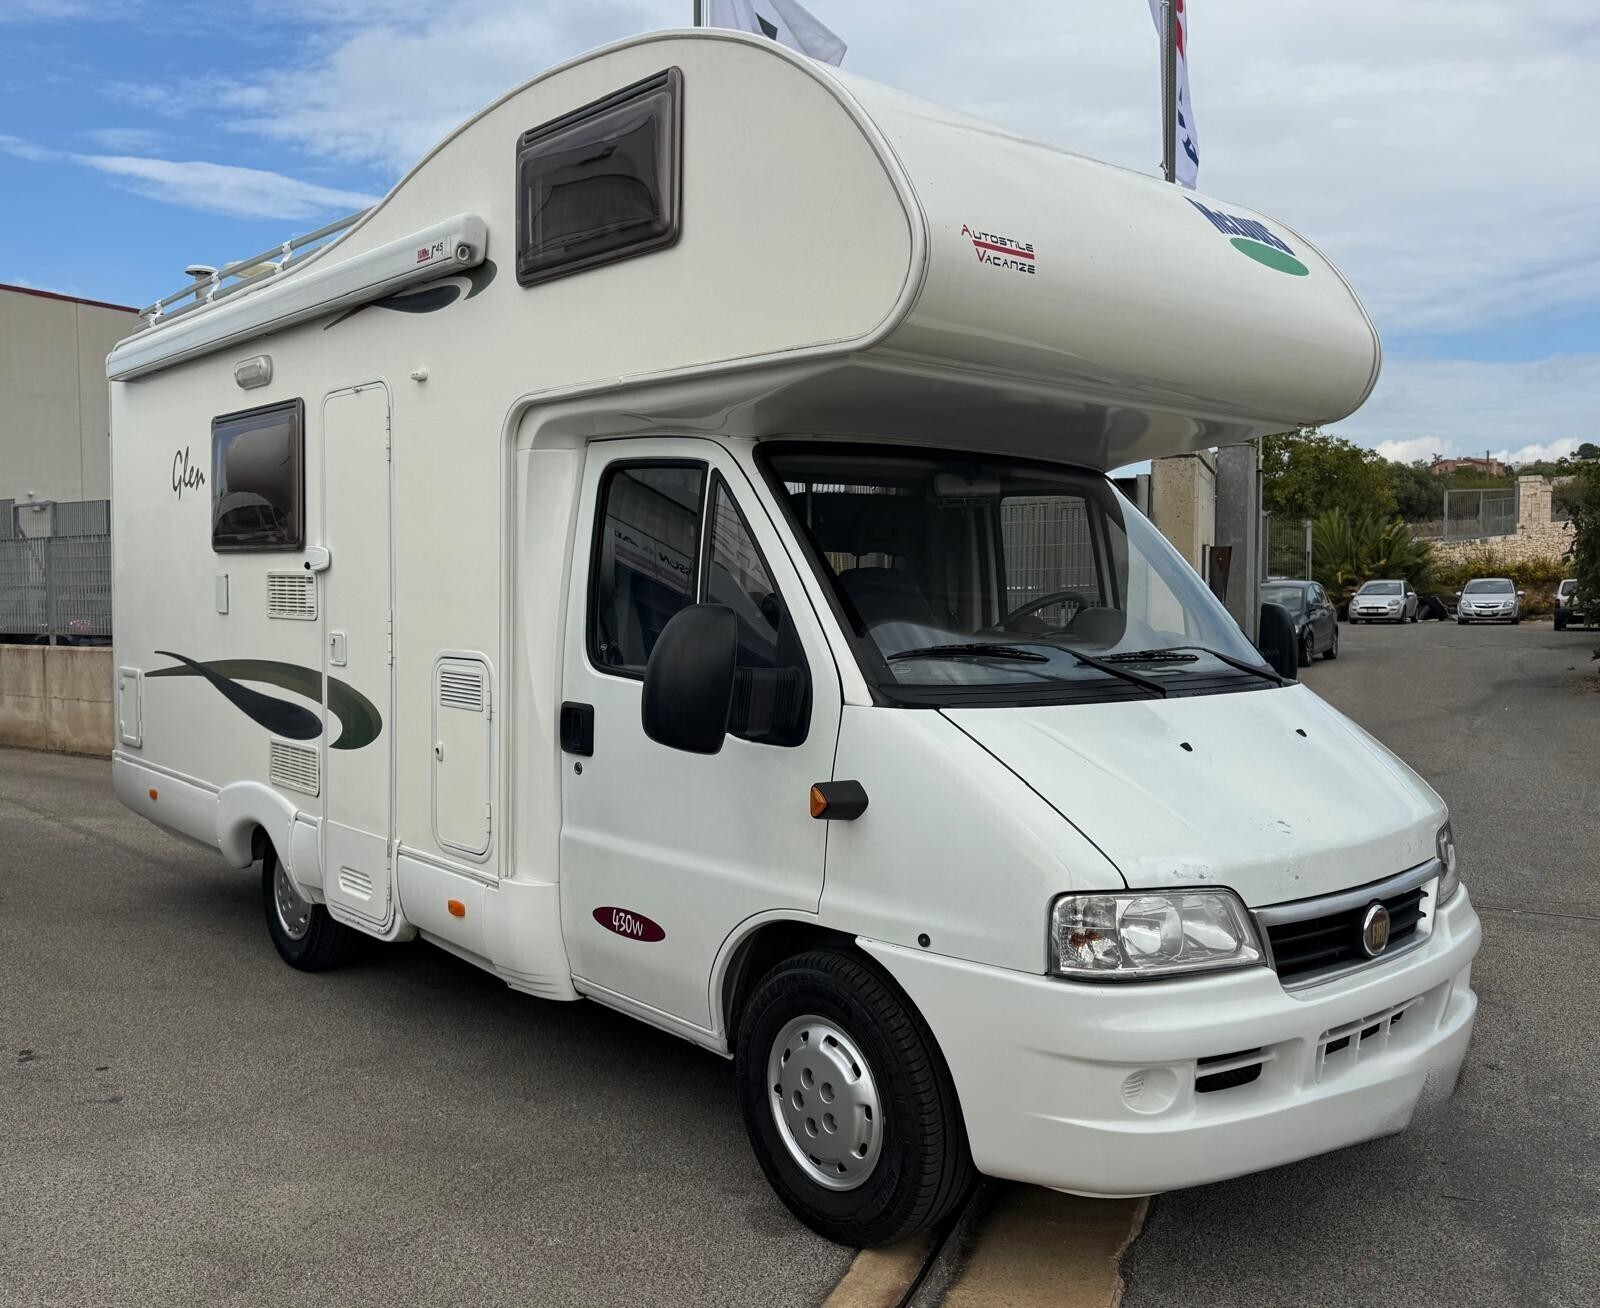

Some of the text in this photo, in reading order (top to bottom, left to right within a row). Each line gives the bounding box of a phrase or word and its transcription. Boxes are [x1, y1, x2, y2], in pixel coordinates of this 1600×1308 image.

[961, 224, 1034, 253] AUTOSTILE
[976, 247, 1036, 275] VACANZE
[172, 446, 206, 501] Glen
